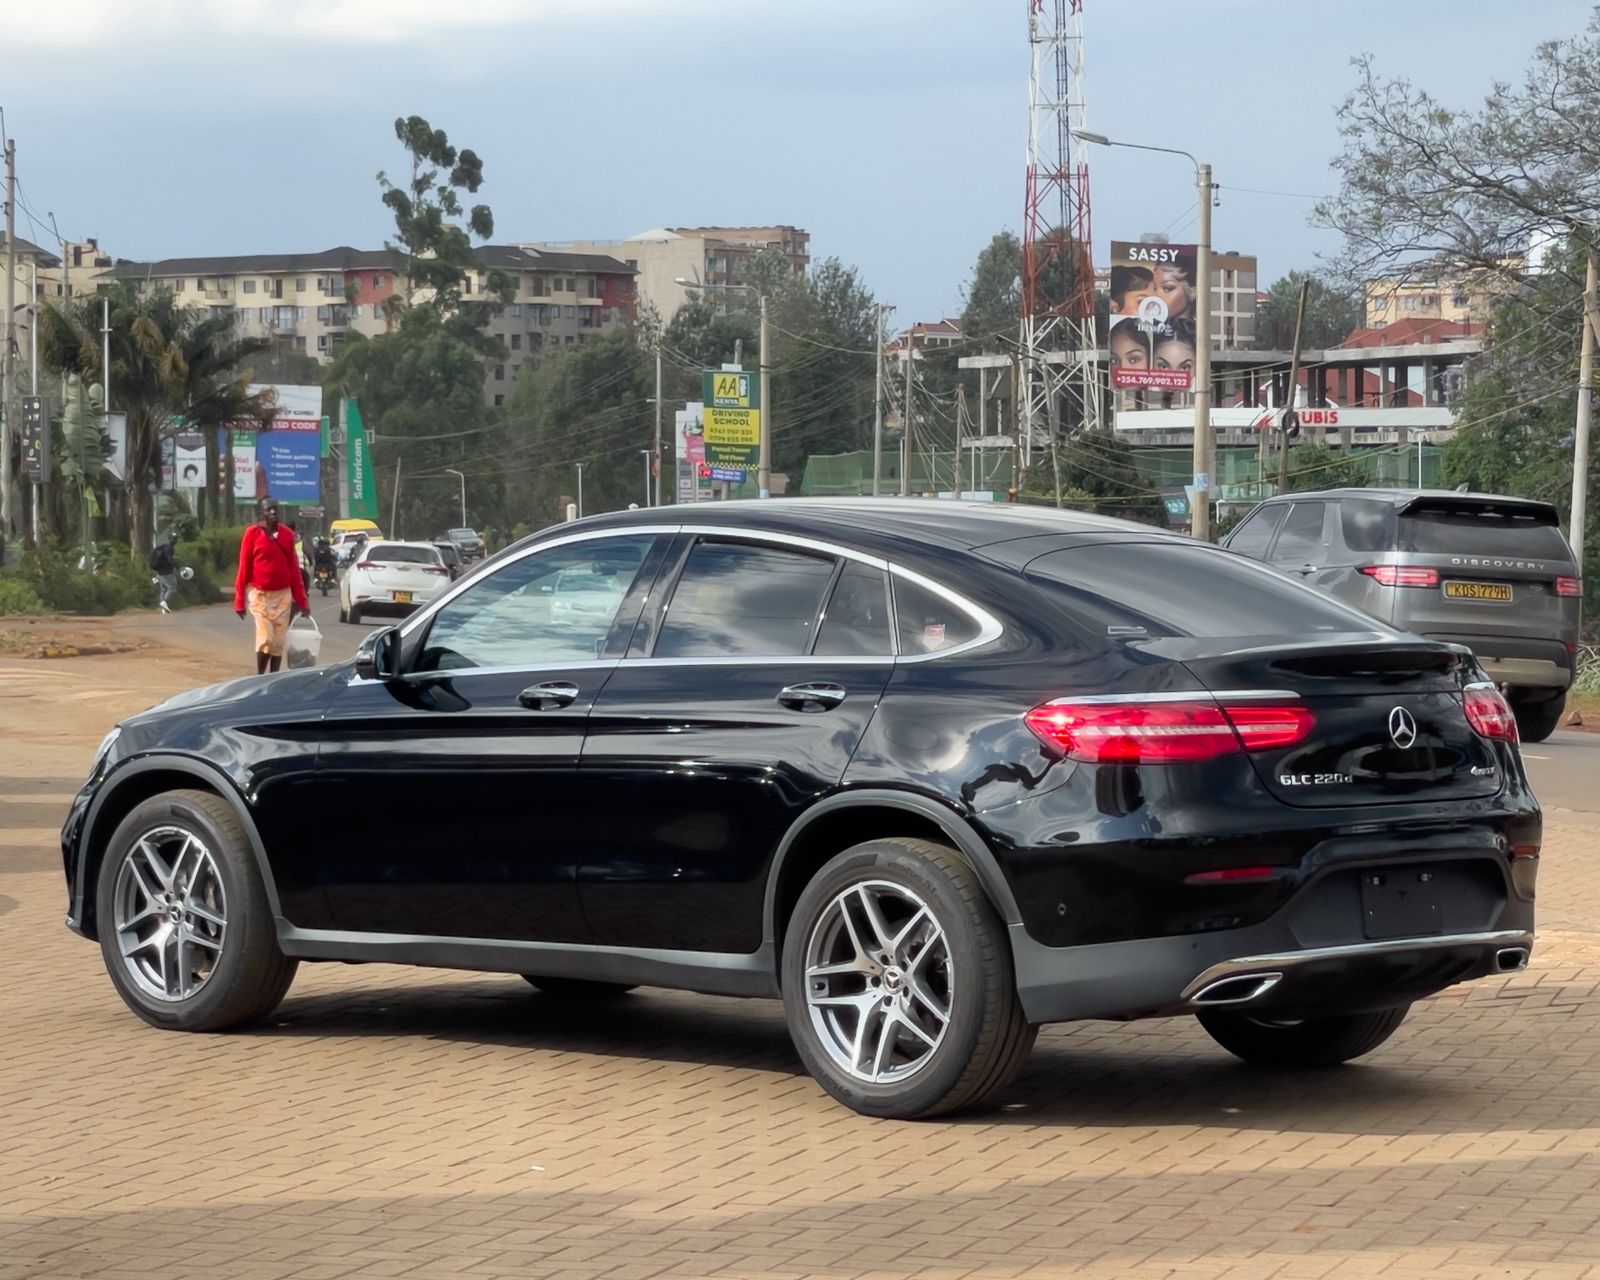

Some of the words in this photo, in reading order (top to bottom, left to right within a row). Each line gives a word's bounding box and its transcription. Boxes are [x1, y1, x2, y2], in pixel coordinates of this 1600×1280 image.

[1128, 247, 1179, 262] SASSY
[717, 377, 737, 396] AA
[291, 421, 317, 430] CODE
[353, 438, 364, 500] Safaricom
[1451, 558, 1545, 570] DISCOVERY
[1481, 585, 1508, 598] 779H
[1280, 774, 1312, 785] GLC
